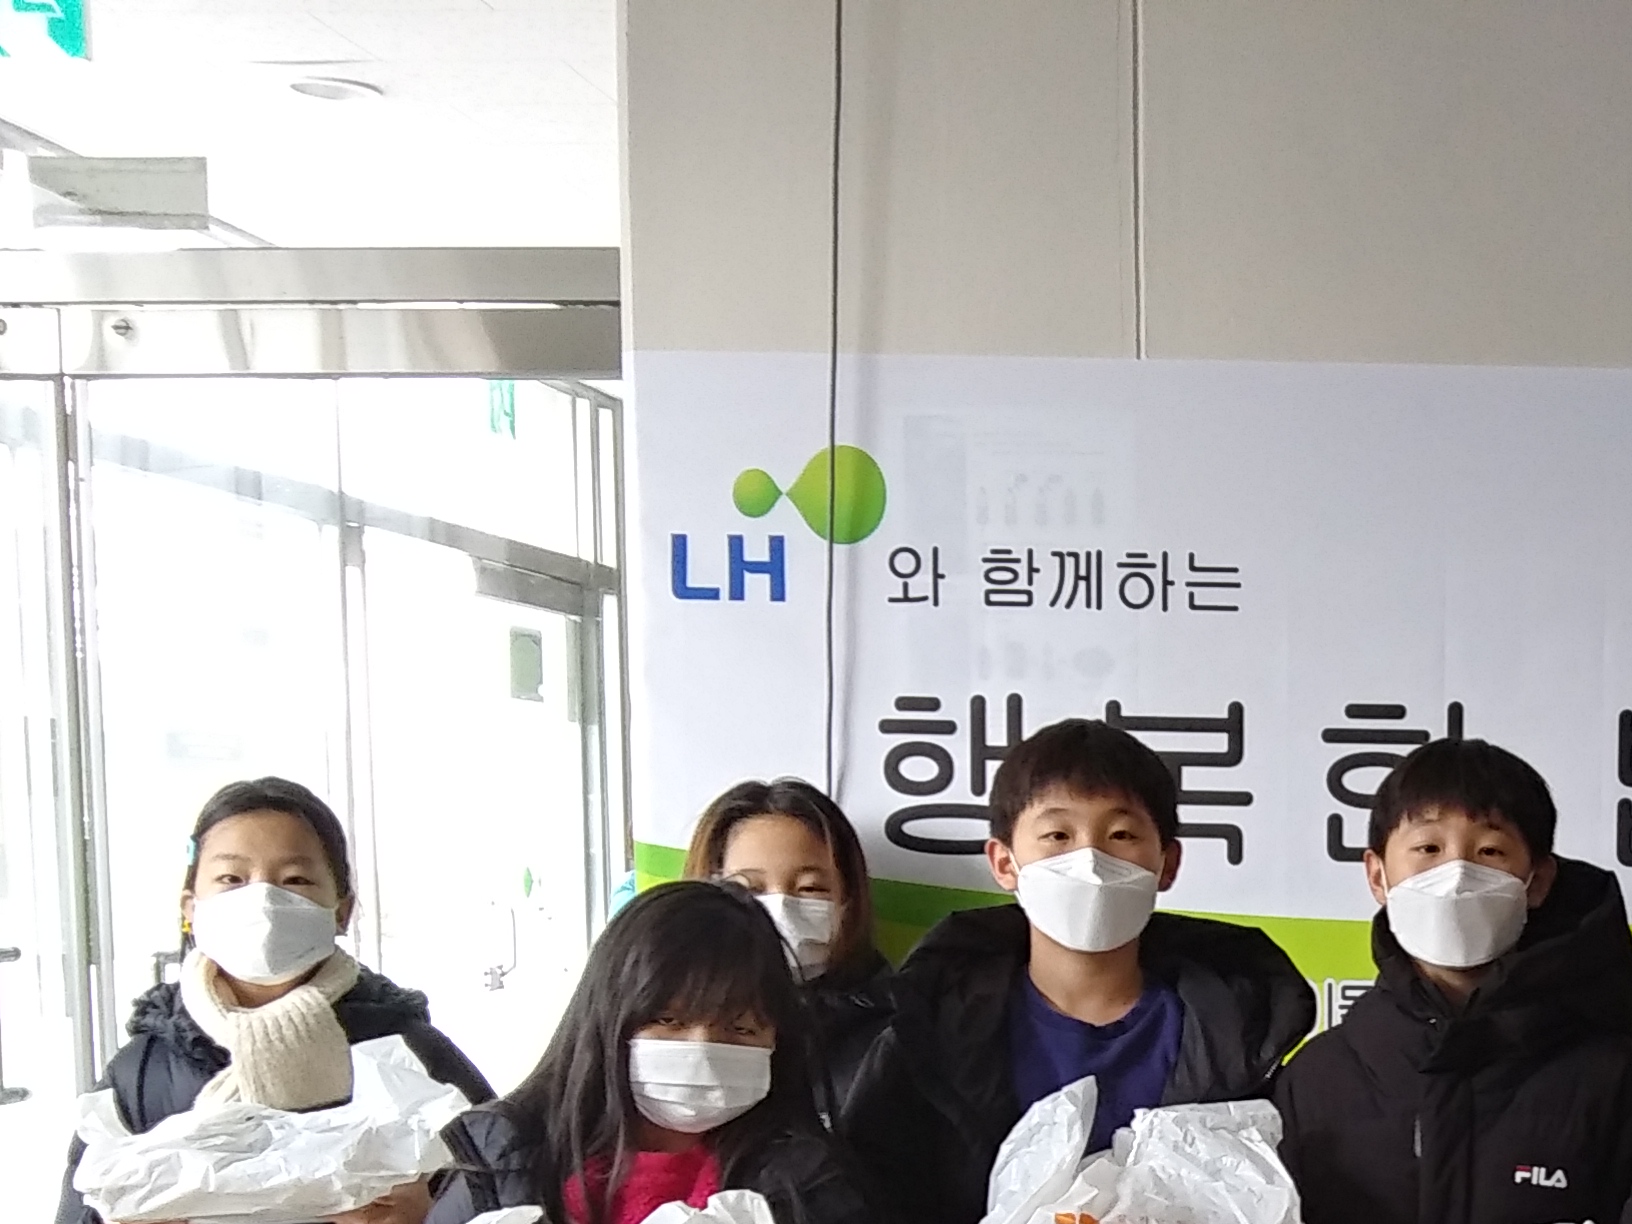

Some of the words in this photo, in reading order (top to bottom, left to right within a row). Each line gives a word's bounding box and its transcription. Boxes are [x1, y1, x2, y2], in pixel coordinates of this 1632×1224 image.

[670, 533, 787, 603] LH
[887, 546, 946, 608] 와
[981, 547, 1243, 613] 함께하는
[1514, 1165, 1568, 1188] FILA
